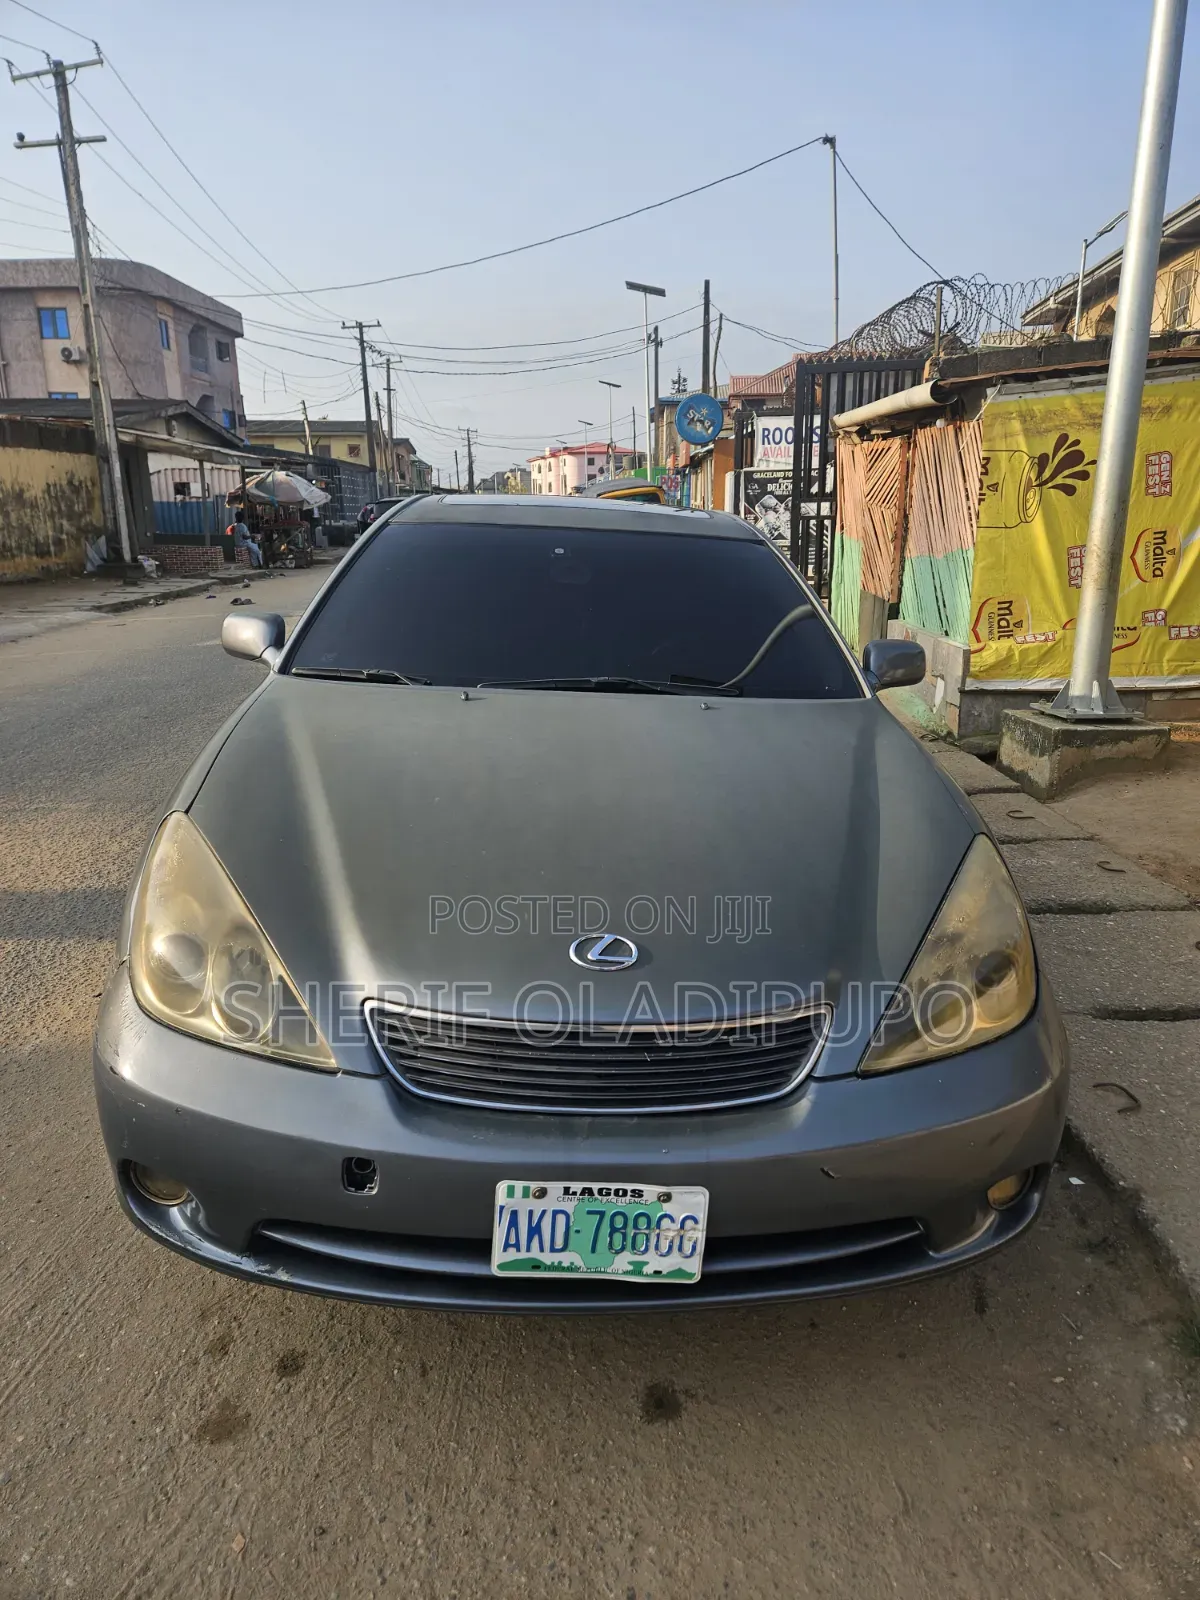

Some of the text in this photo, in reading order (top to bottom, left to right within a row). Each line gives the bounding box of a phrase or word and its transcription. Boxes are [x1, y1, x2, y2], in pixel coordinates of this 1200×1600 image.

[762, 426, 821, 446] ROOS
[763, 445, 819, 459] AVAILE
[1147, 454, 1159, 495] FEST
[1152, 530, 1167, 579] Malta
[1070, 548, 1082, 587] FEST
[988, 612, 996, 641] GUINNES
[997, 600, 1013, 640] Malt
[1170, 626, 1200, 638] FES
[562, 1186, 645, 1199] LAGOS
[600, 1197, 649, 1206] EXCELLENCE
